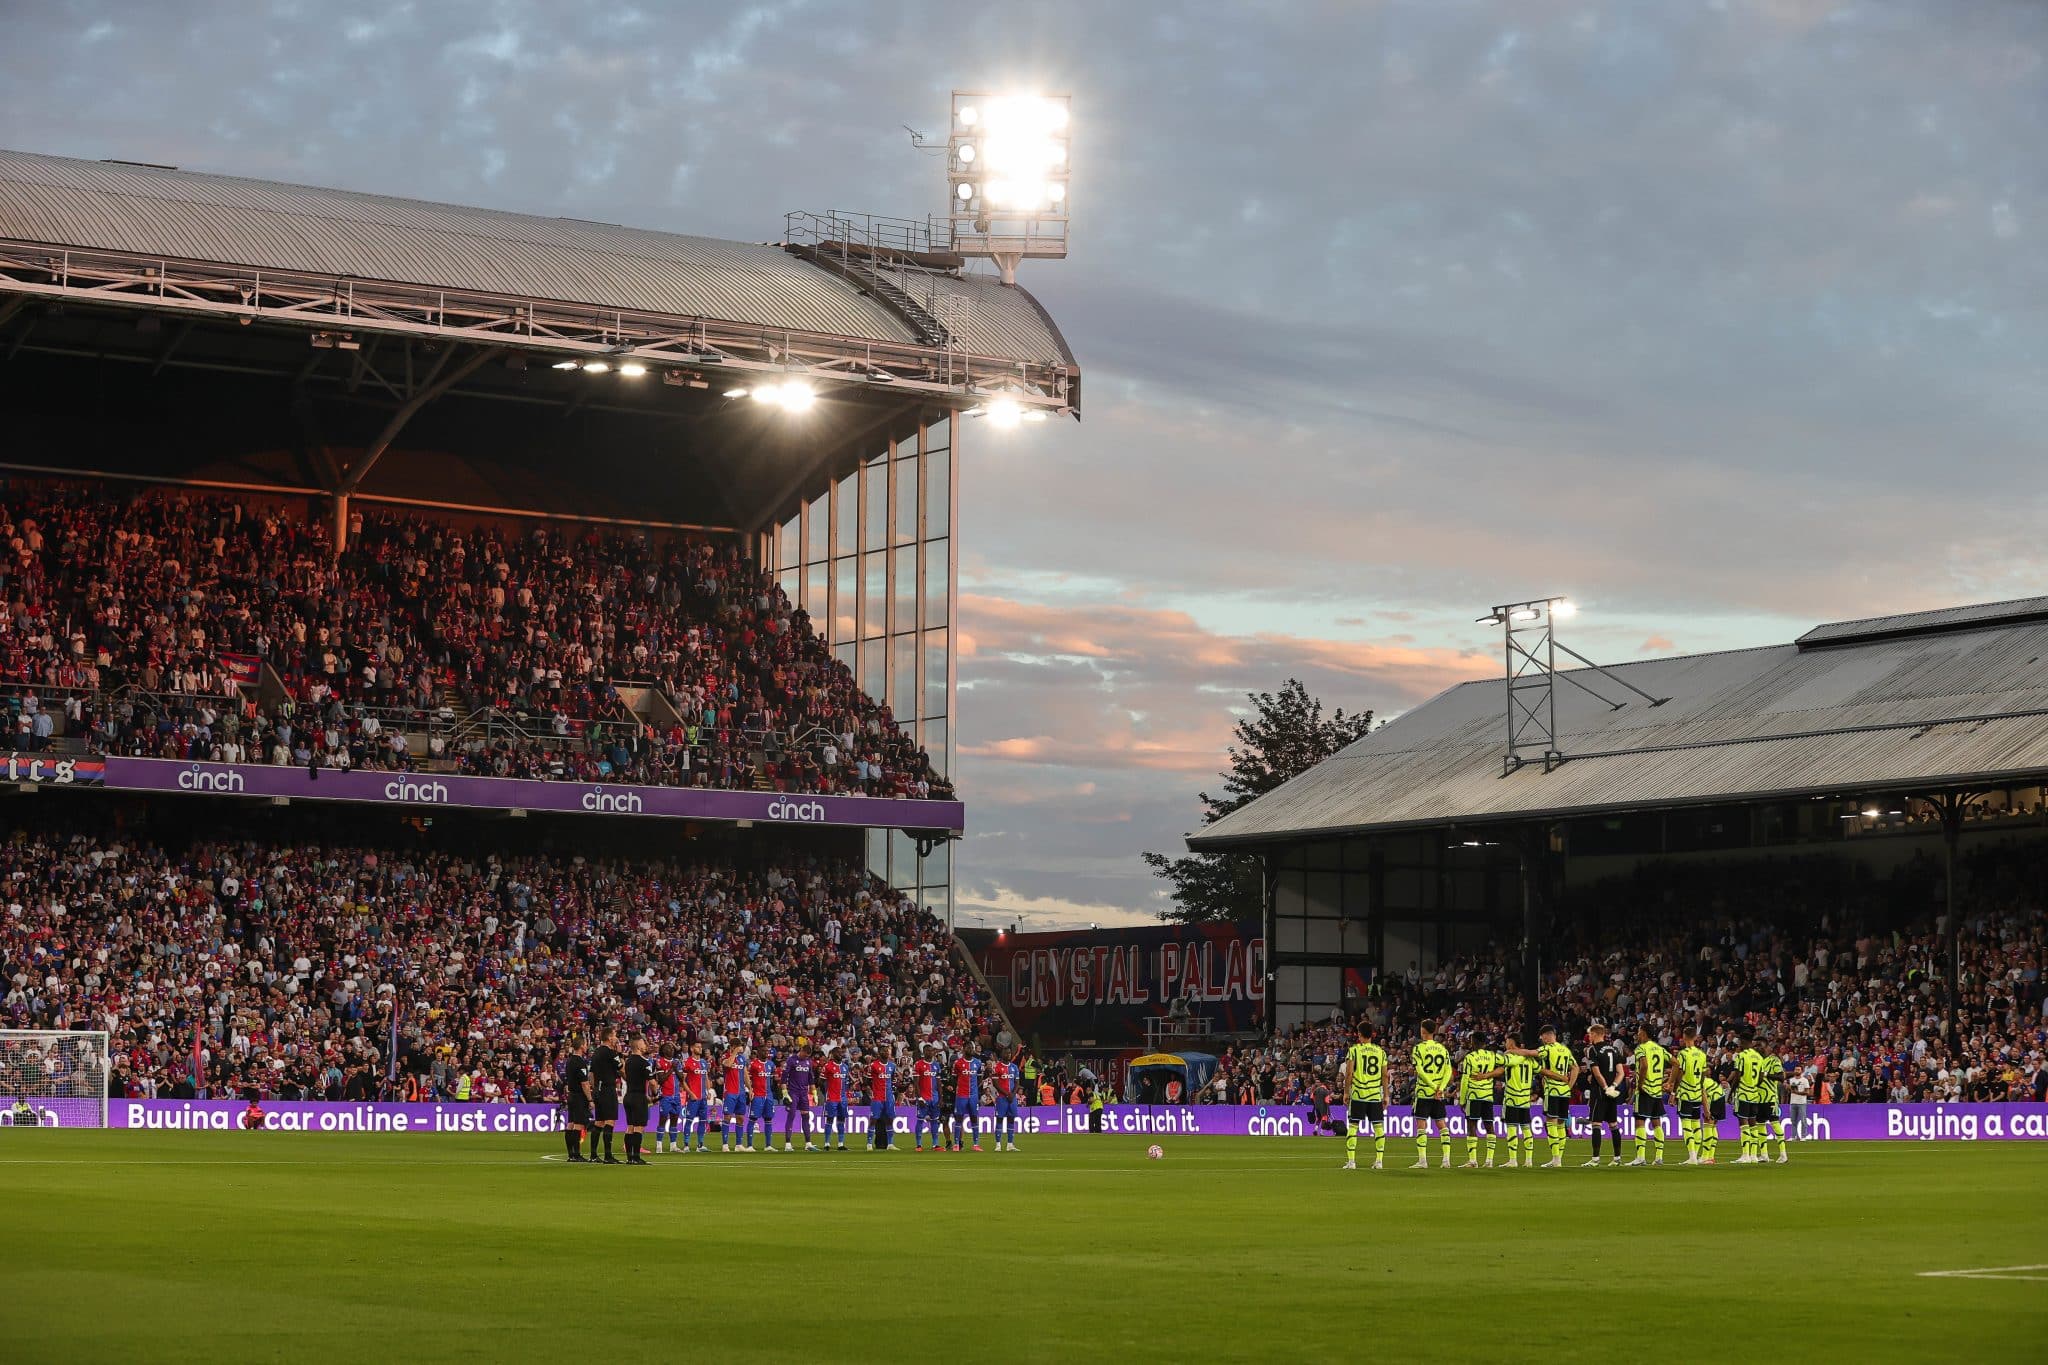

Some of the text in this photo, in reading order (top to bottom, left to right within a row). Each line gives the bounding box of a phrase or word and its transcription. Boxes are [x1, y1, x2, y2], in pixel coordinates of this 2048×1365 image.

[178, 763, 243, 791] cinch
[384, 775, 447, 802] cinch
[582, 785, 642, 812] cinch
[767, 795, 824, 821] cinch
[1011, 945, 1149, 1008] CRYSTAL
[1361, 1055, 1379, 1076] 18
[1423, 1054, 1445, 1074] 29
[1519, 1064, 1529, 1084] 11
[1555, 1055, 1569, 1077] 41
[1607, 1052, 1614, 1072] 1
[1652, 1054, 1661, 1073] 2
[1693, 1060, 1701, 1079] 4
[1751, 1062, 1758, 1079] 5
[264, 1110, 314, 1131] car
[319, 1104, 407, 1131] online
[435, 1106, 487, 1132] just
[1123, 1108, 1176, 1133] cinch
[1181, 1108, 1200, 1132] it.
[1248, 1107, 1303, 1136] cinch
[1888, 1107, 1977, 1140] Buying
[1984, 1115, 2003, 1136] a
